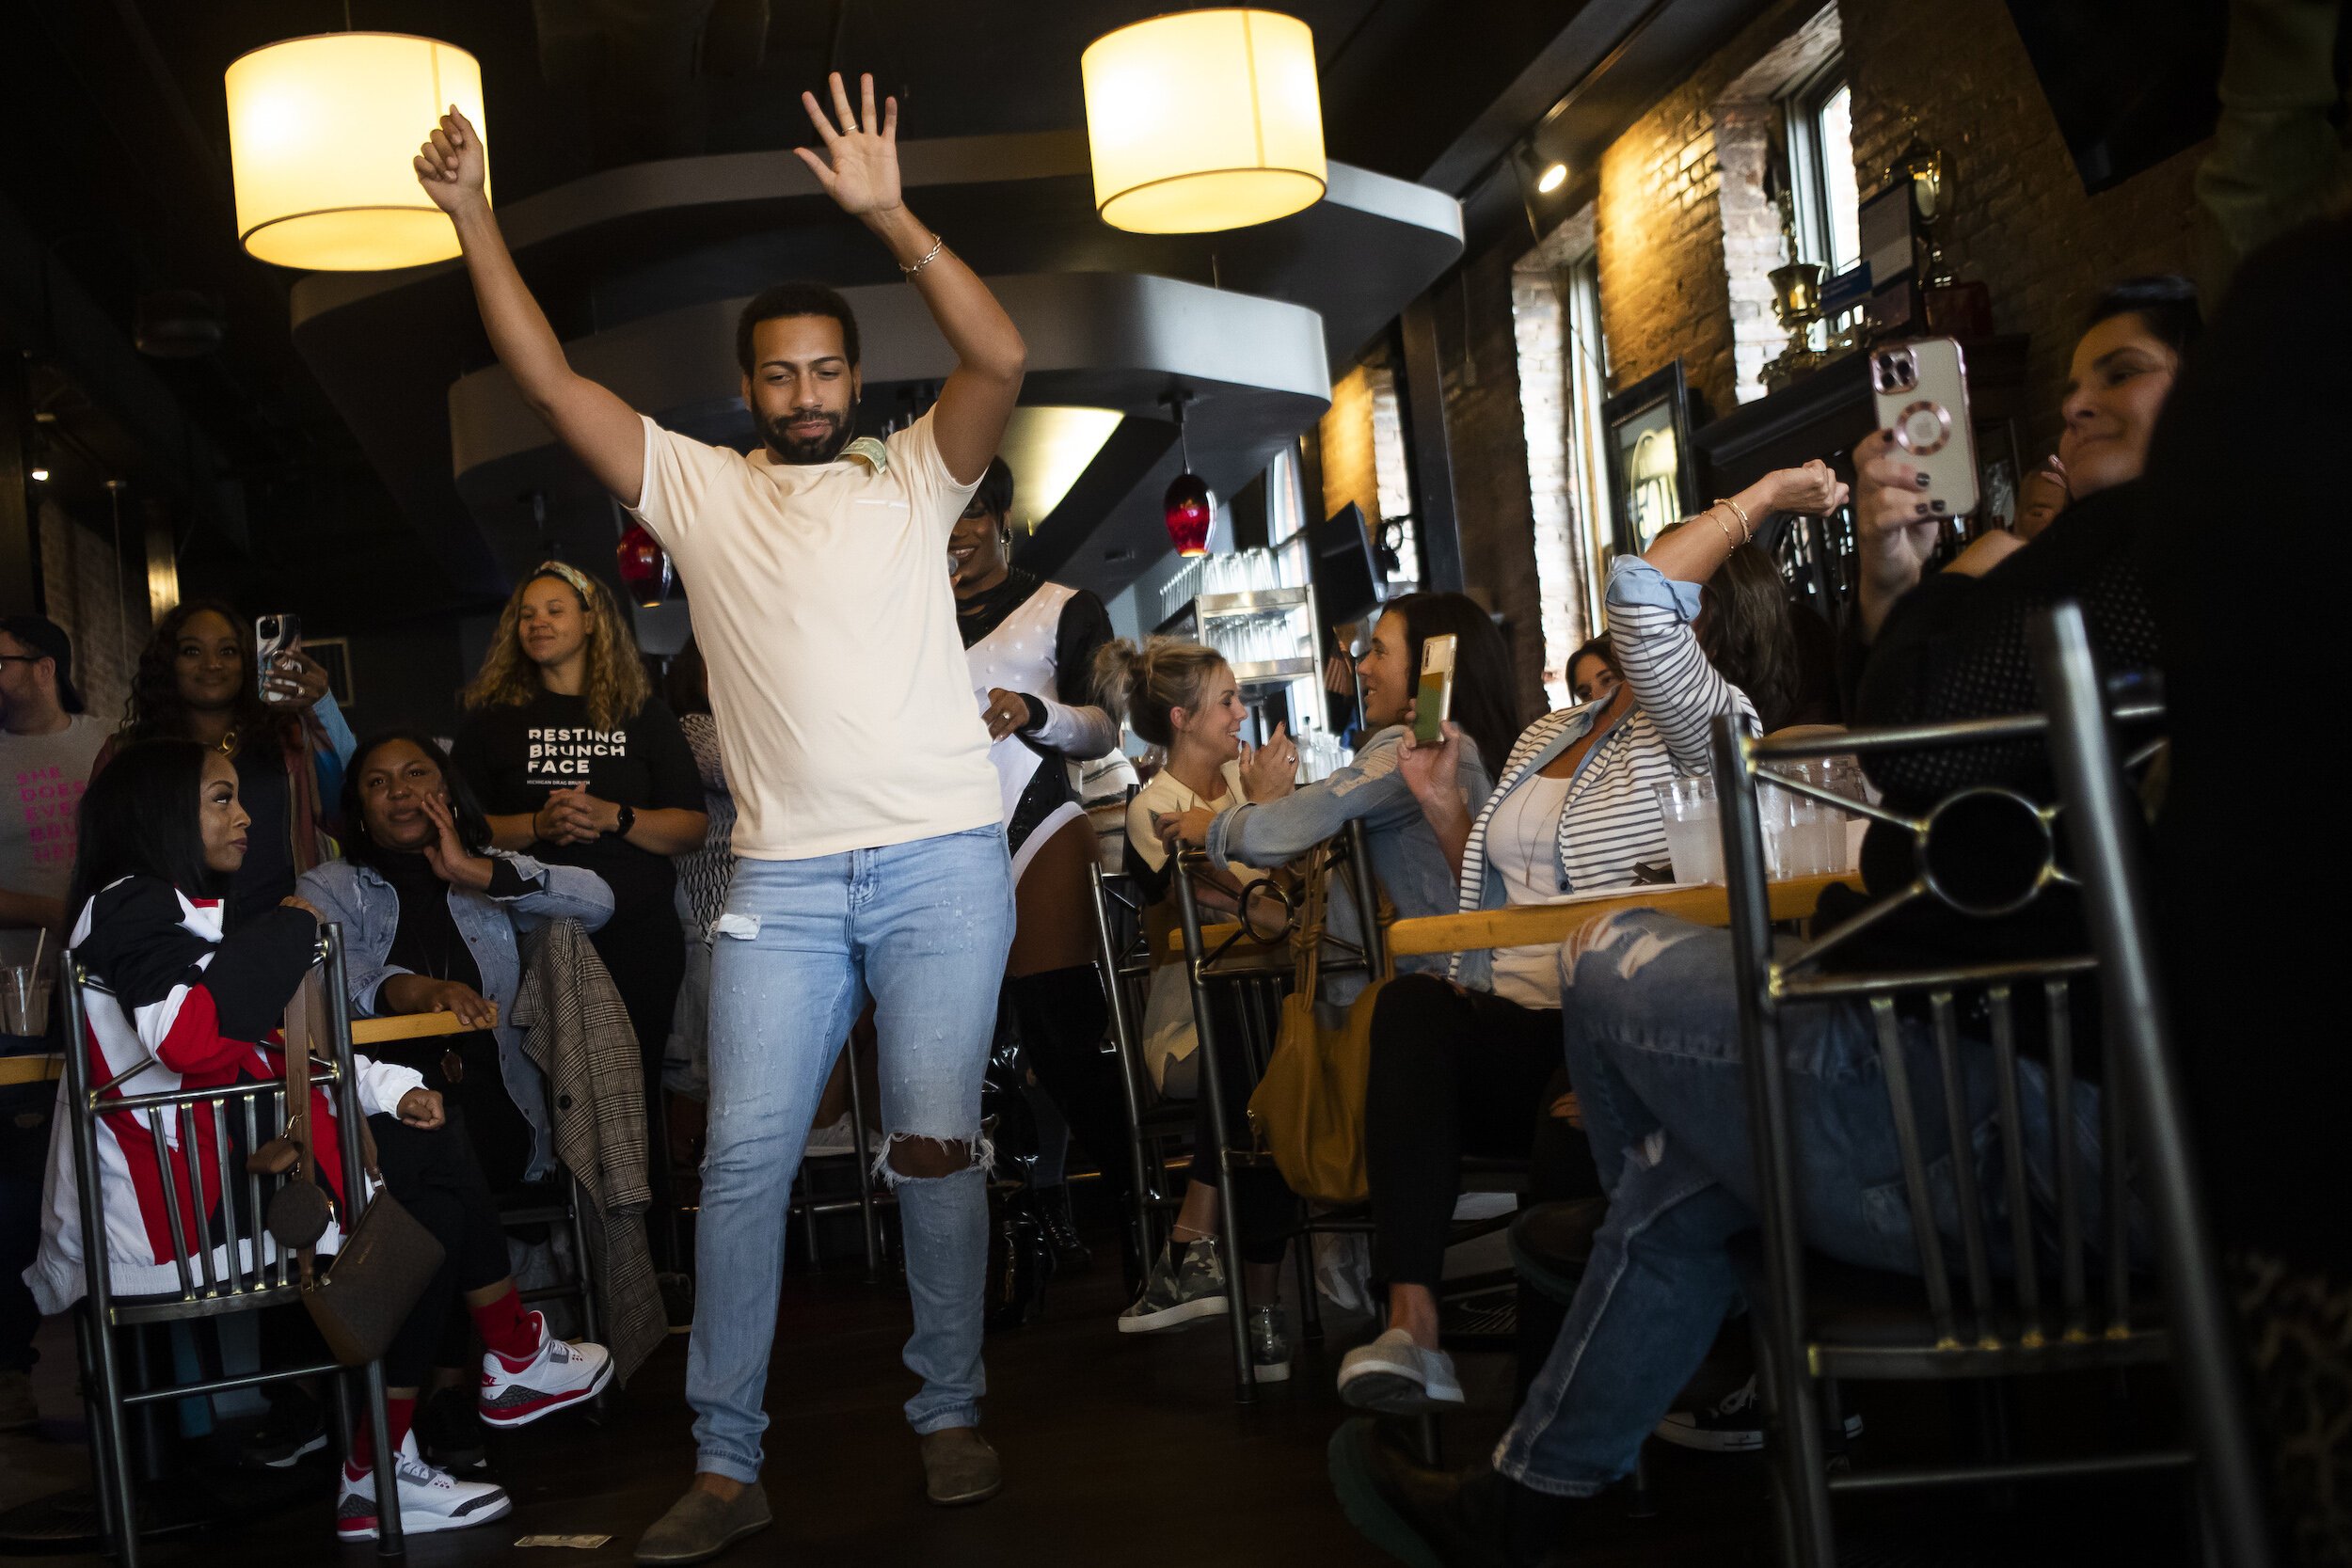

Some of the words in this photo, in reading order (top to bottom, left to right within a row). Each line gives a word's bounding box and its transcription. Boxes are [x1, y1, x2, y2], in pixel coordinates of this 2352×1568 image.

[528, 729, 627, 743] RESTING
[530, 744, 626, 758] BRUNCH
[528, 760, 590, 774] FACE
